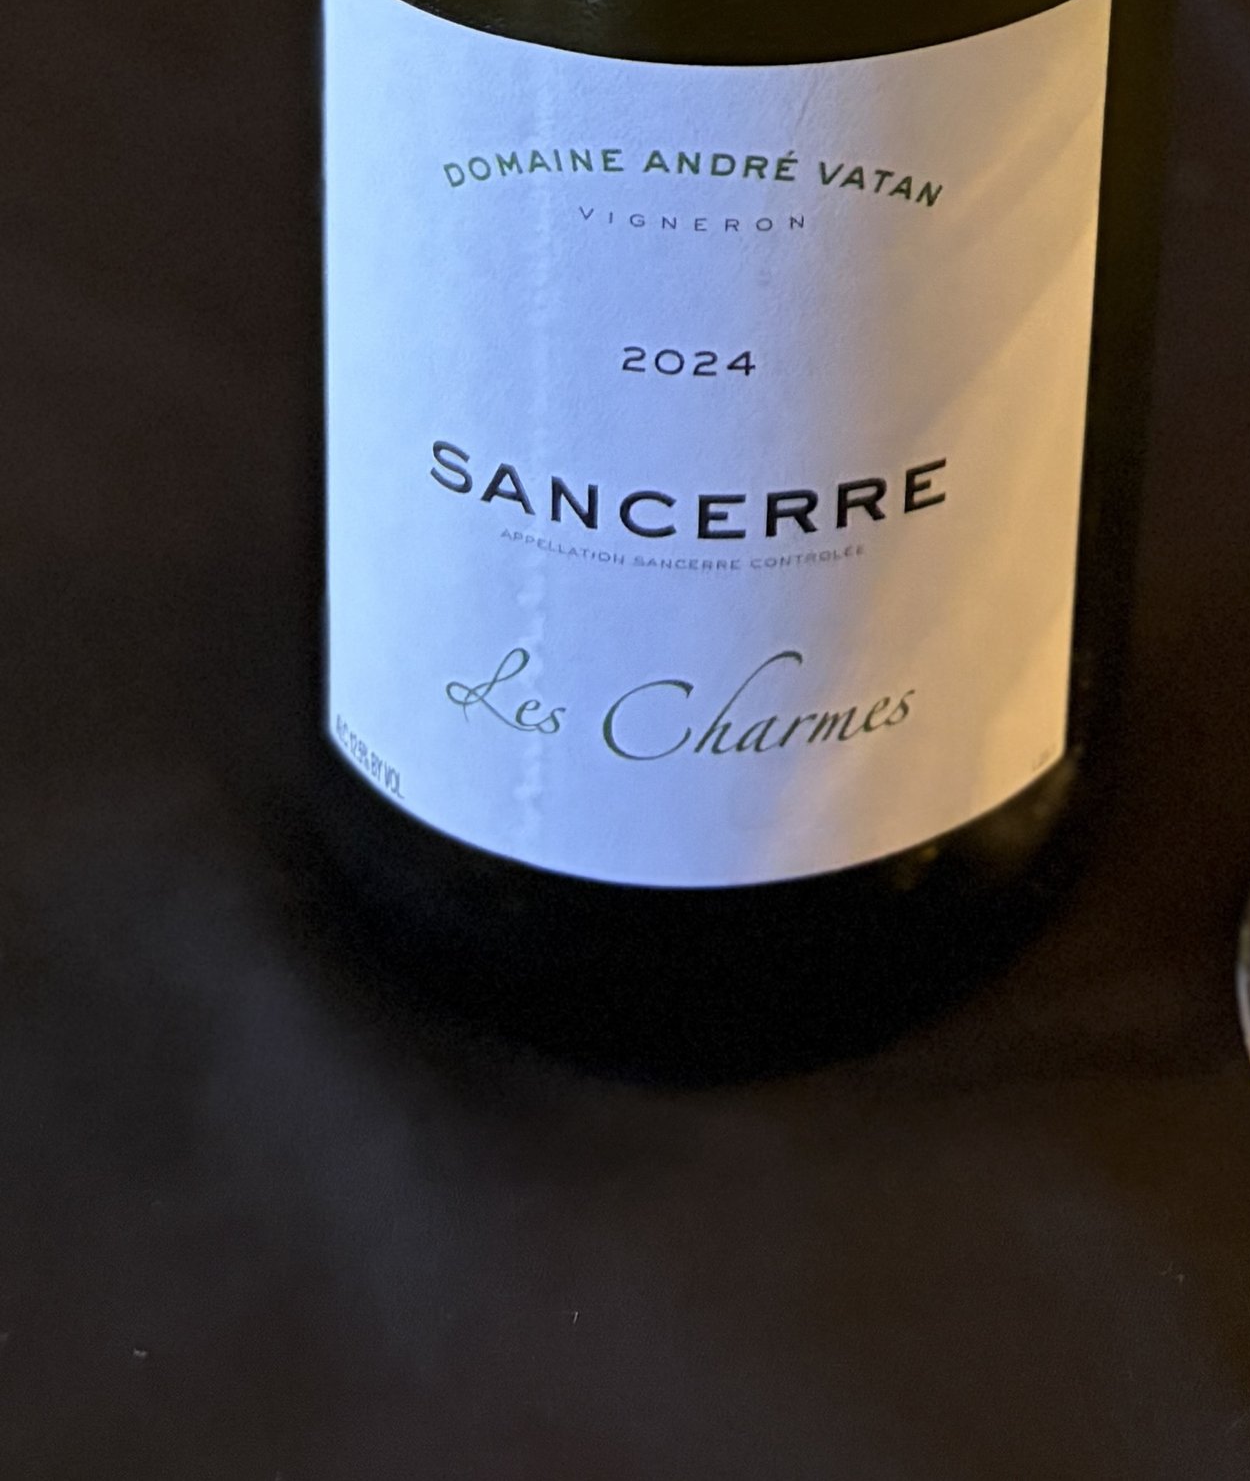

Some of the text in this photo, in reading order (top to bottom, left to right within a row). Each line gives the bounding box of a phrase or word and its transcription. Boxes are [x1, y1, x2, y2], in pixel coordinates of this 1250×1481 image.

[443, 148, 943, 208] DOMAINE ANDRÉ VATAN
[579, 205, 805, 233] VIGNERON
[621, 345, 757, 377] 2024
[430, 440, 947, 540] SANCERRE
[500, 527, 626, 566] APPELLATION
[633, 554, 742, 572] SANCERRE
[445, 647, 916, 762] Les Charmes
